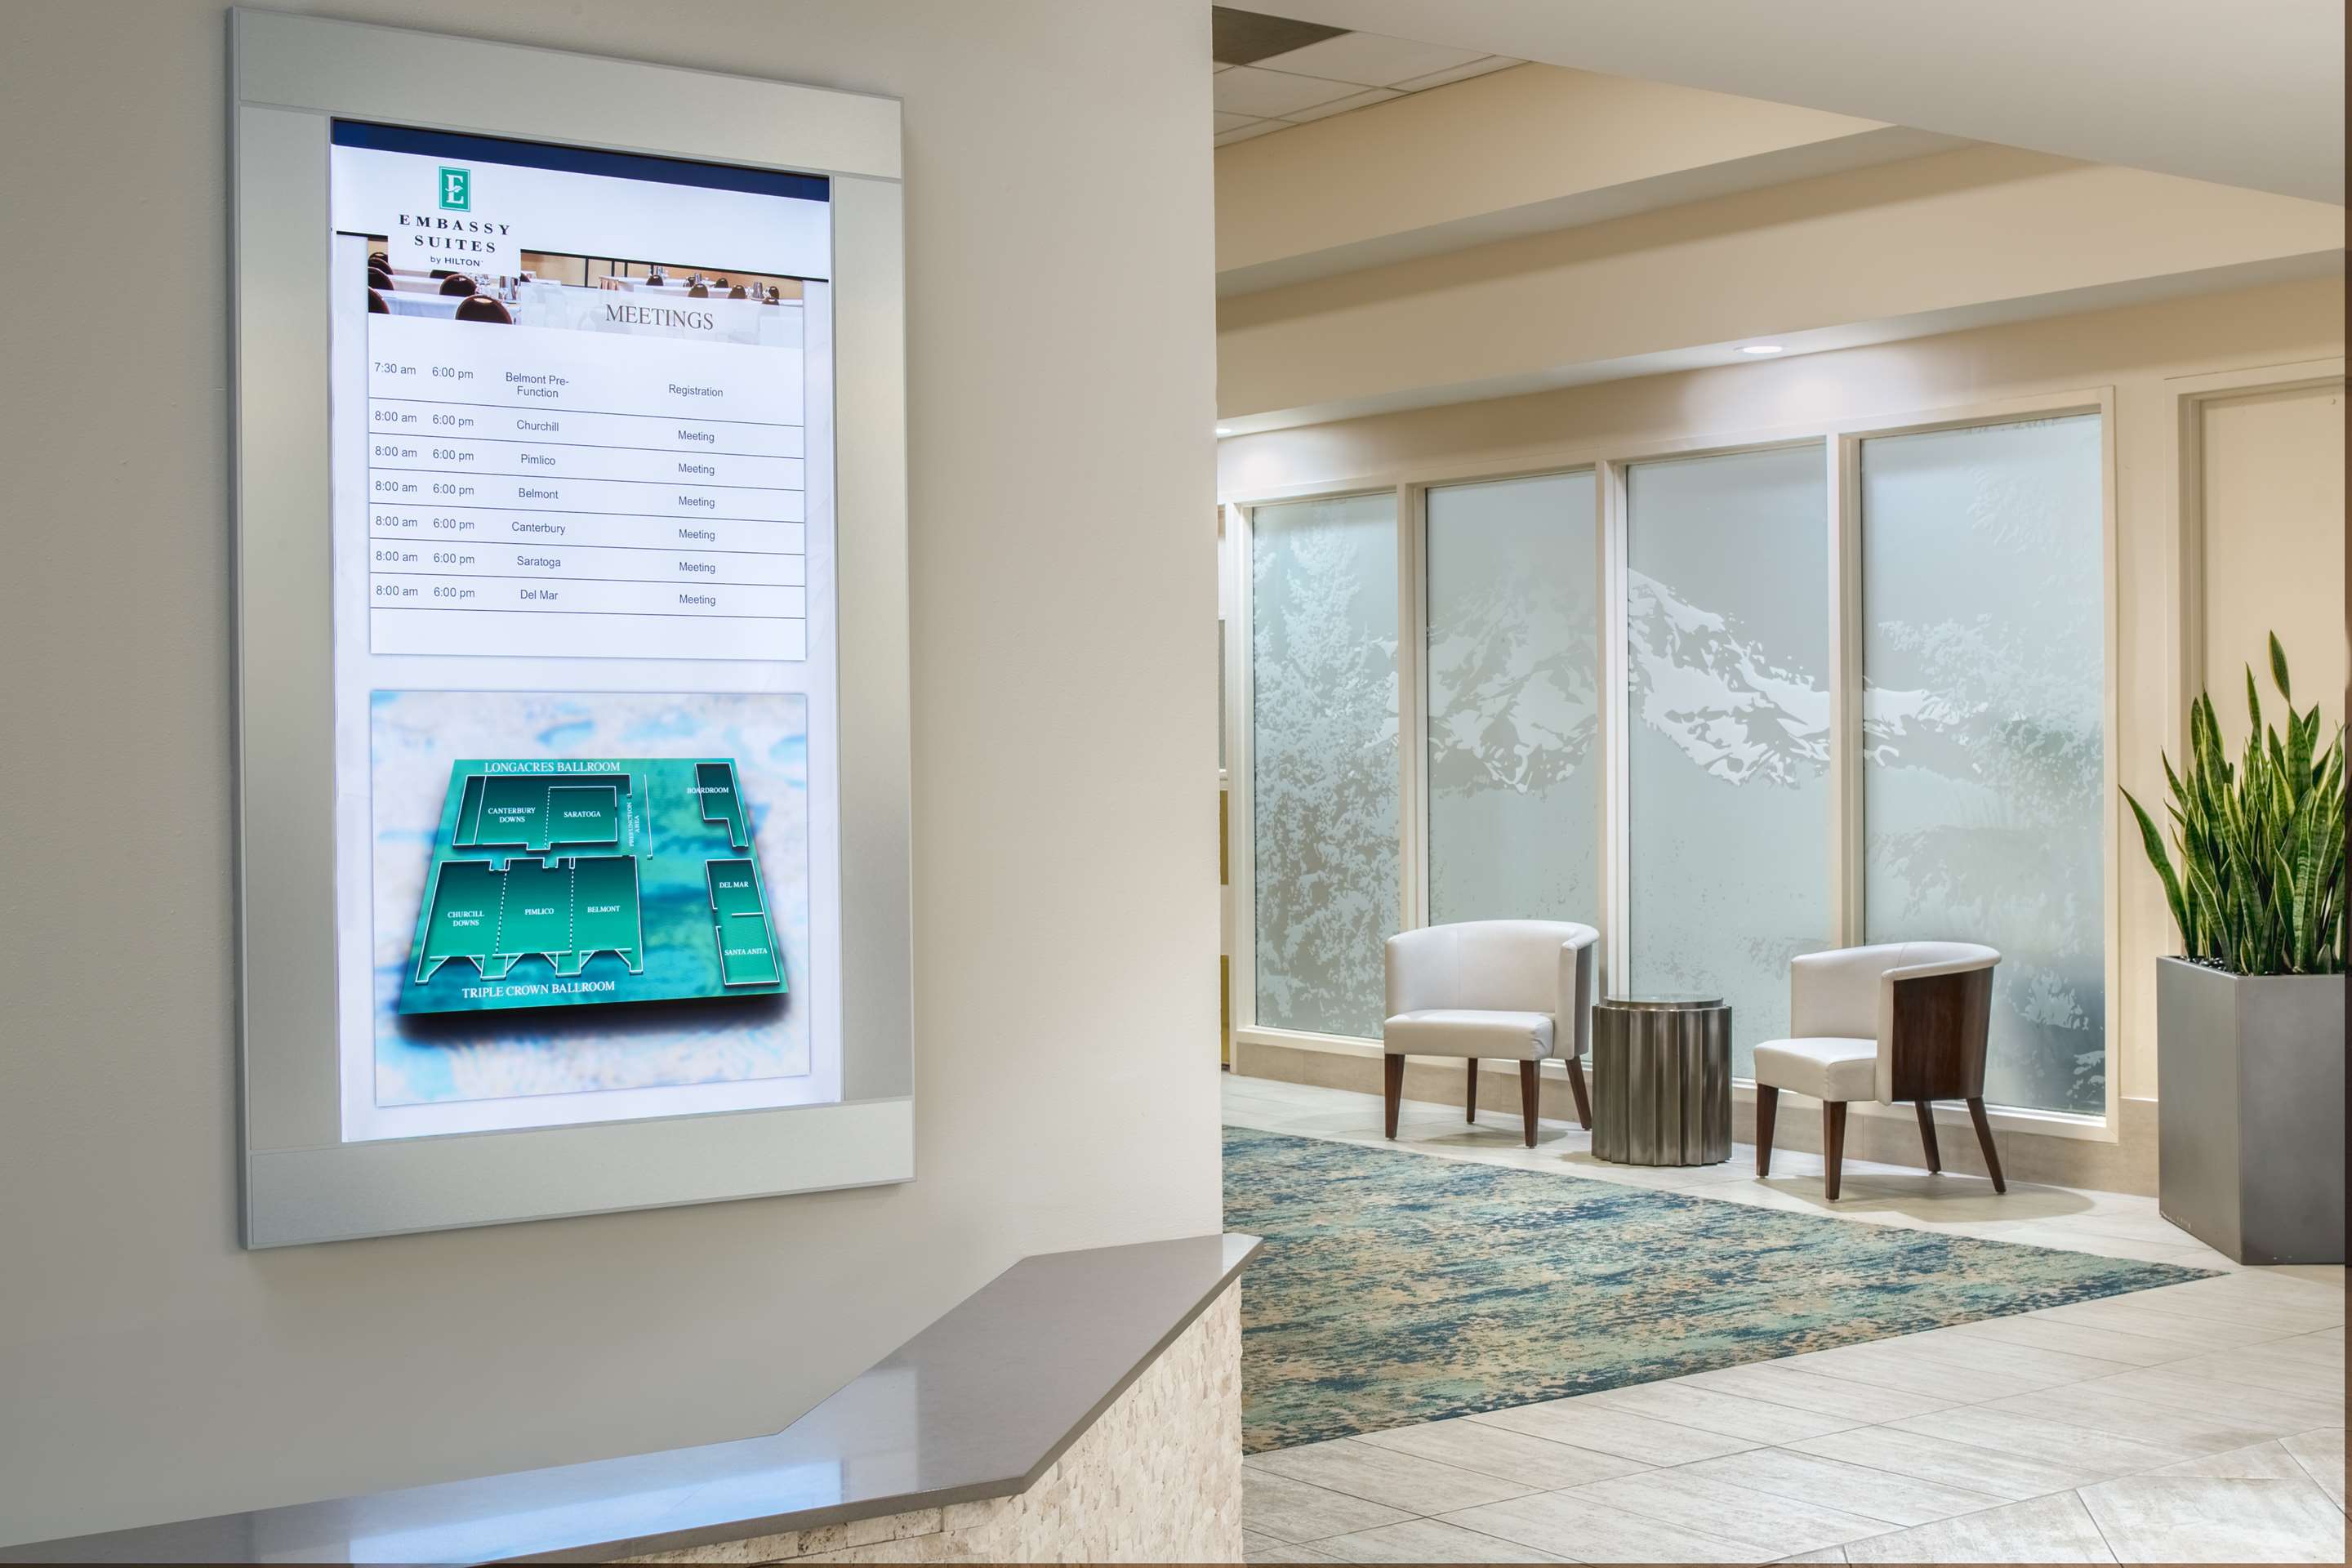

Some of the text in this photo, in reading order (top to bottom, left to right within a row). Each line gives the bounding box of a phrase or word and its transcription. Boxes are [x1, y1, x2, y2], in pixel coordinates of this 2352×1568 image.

[399, 214, 510, 235] EMBASSY
[415, 235, 496, 253] SUITES
[430, 256, 480, 266] by HILTON
[606, 304, 713, 330] MEETINGS
[374, 363, 416, 375] 7:30 am
[432, 367, 474, 381] 6:00 pm
[506, 372, 569, 386] Belmont Pre-
[516, 386, 559, 399] Function
[669, 384, 724, 398] Registration
[374, 411, 417, 423] 8:00 am
[432, 414, 474, 427] 6:00 pm
[516, 420, 559, 432] Churchill
[677, 430, 715, 443] Meeting
[375, 446, 417, 457] 8:00 am
[433, 449, 474, 462] 6:00 pm
[520, 454, 555, 466] Pimlico
[678, 463, 715, 476] Meeting
[375, 481, 418, 492] 8:00 am
[433, 483, 474, 497] 6:00 pm
[519, 488, 558, 500] Belmont
[678, 496, 716, 509] Meeting
[376, 516, 418, 528] 8:00 am
[433, 519, 474, 532] 6:00 pm
[511, 522, 565, 536] Canterbury
[679, 528, 716, 542] Meeting
[376, 551, 418, 563] 8:00 am
[433, 553, 475, 566] 6:00 pm
[516, 556, 561, 568] Saratoga
[679, 561, 716, 575] Meeting
[376, 586, 418, 597] 8:00 am
[434, 587, 475, 600] 6:00 pm
[520, 590, 558, 600] Del Mar
[679, 594, 717, 608] Meeting
[485, 762, 620, 773] LONGACRES BALLROOM
[462, 982, 615, 998] TRIPLE CROWN BALLROOM
